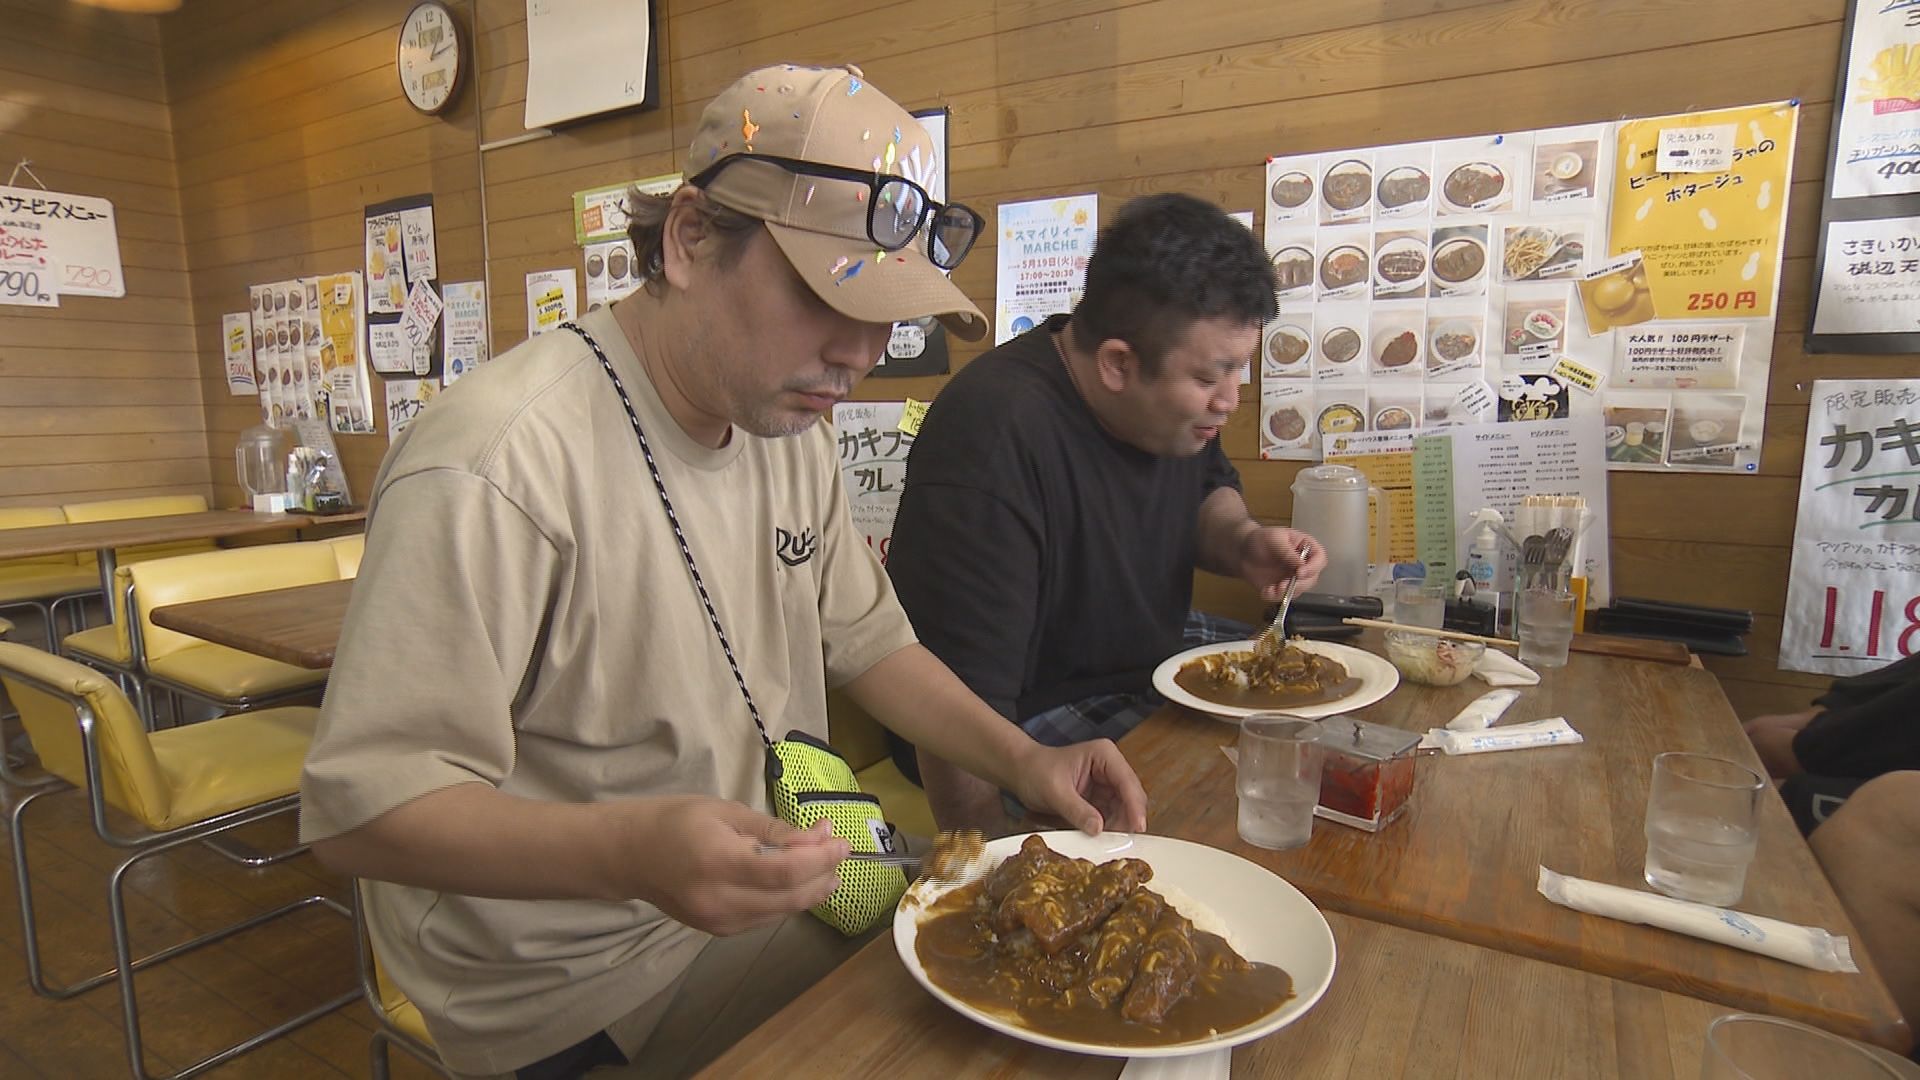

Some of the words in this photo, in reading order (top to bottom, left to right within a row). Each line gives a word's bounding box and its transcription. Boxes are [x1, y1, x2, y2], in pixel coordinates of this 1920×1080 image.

[1665, 173, 1744, 203] ポタージュ
[0, 195, 108, 221] サービスメニュー
[1023, 239, 1079, 256] MARCHE
[1842, 236, 1920, 257] さきいか
[65, 264, 113, 287] 790
[389, 398, 424, 422] カキフ
